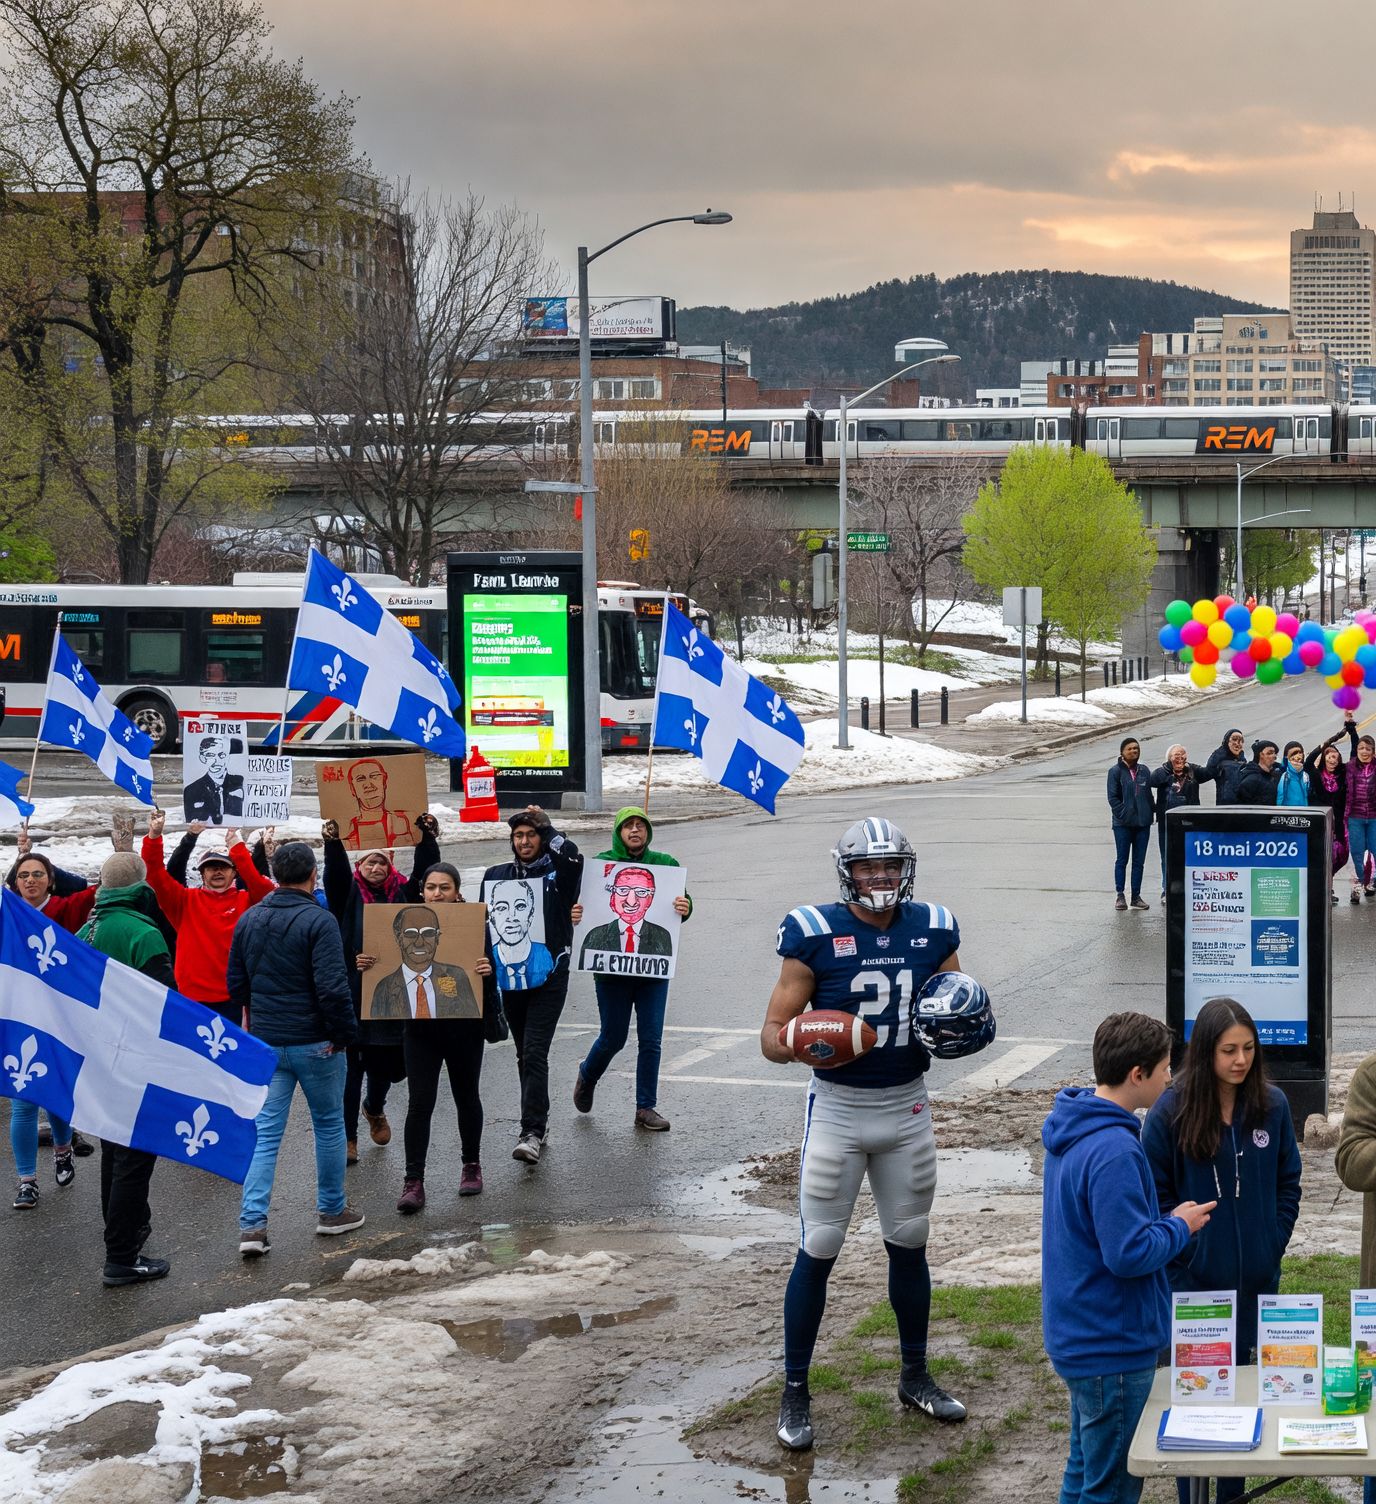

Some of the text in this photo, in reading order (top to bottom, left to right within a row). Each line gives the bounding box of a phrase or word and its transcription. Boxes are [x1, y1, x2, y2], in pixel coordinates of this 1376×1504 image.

[691, 429, 752, 452] REM
[1204, 426, 1276, 449] REM
[1194, 840, 1299, 857] 18 mai 2026
[850, 969, 913, 1048] 21
